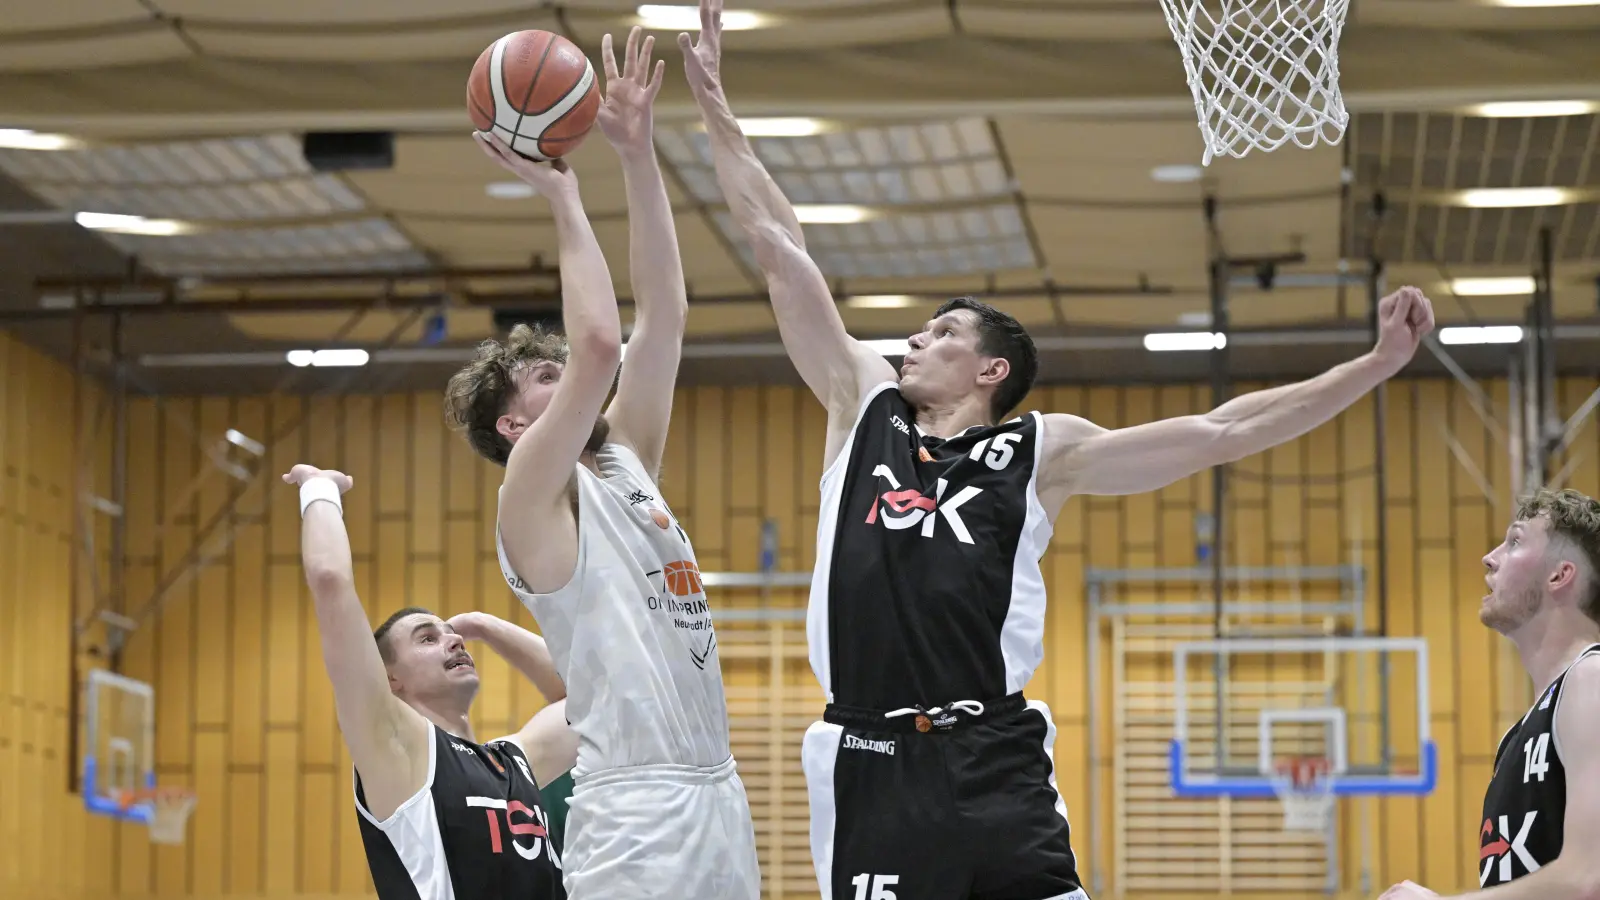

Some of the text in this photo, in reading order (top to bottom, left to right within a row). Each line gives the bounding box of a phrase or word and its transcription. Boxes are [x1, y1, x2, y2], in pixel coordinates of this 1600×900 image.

[968, 432, 1023, 471] 15
[843, 734, 896, 756] SPALDING
[1523, 732, 1551, 784] 14
[851, 872, 900, 900] 15
